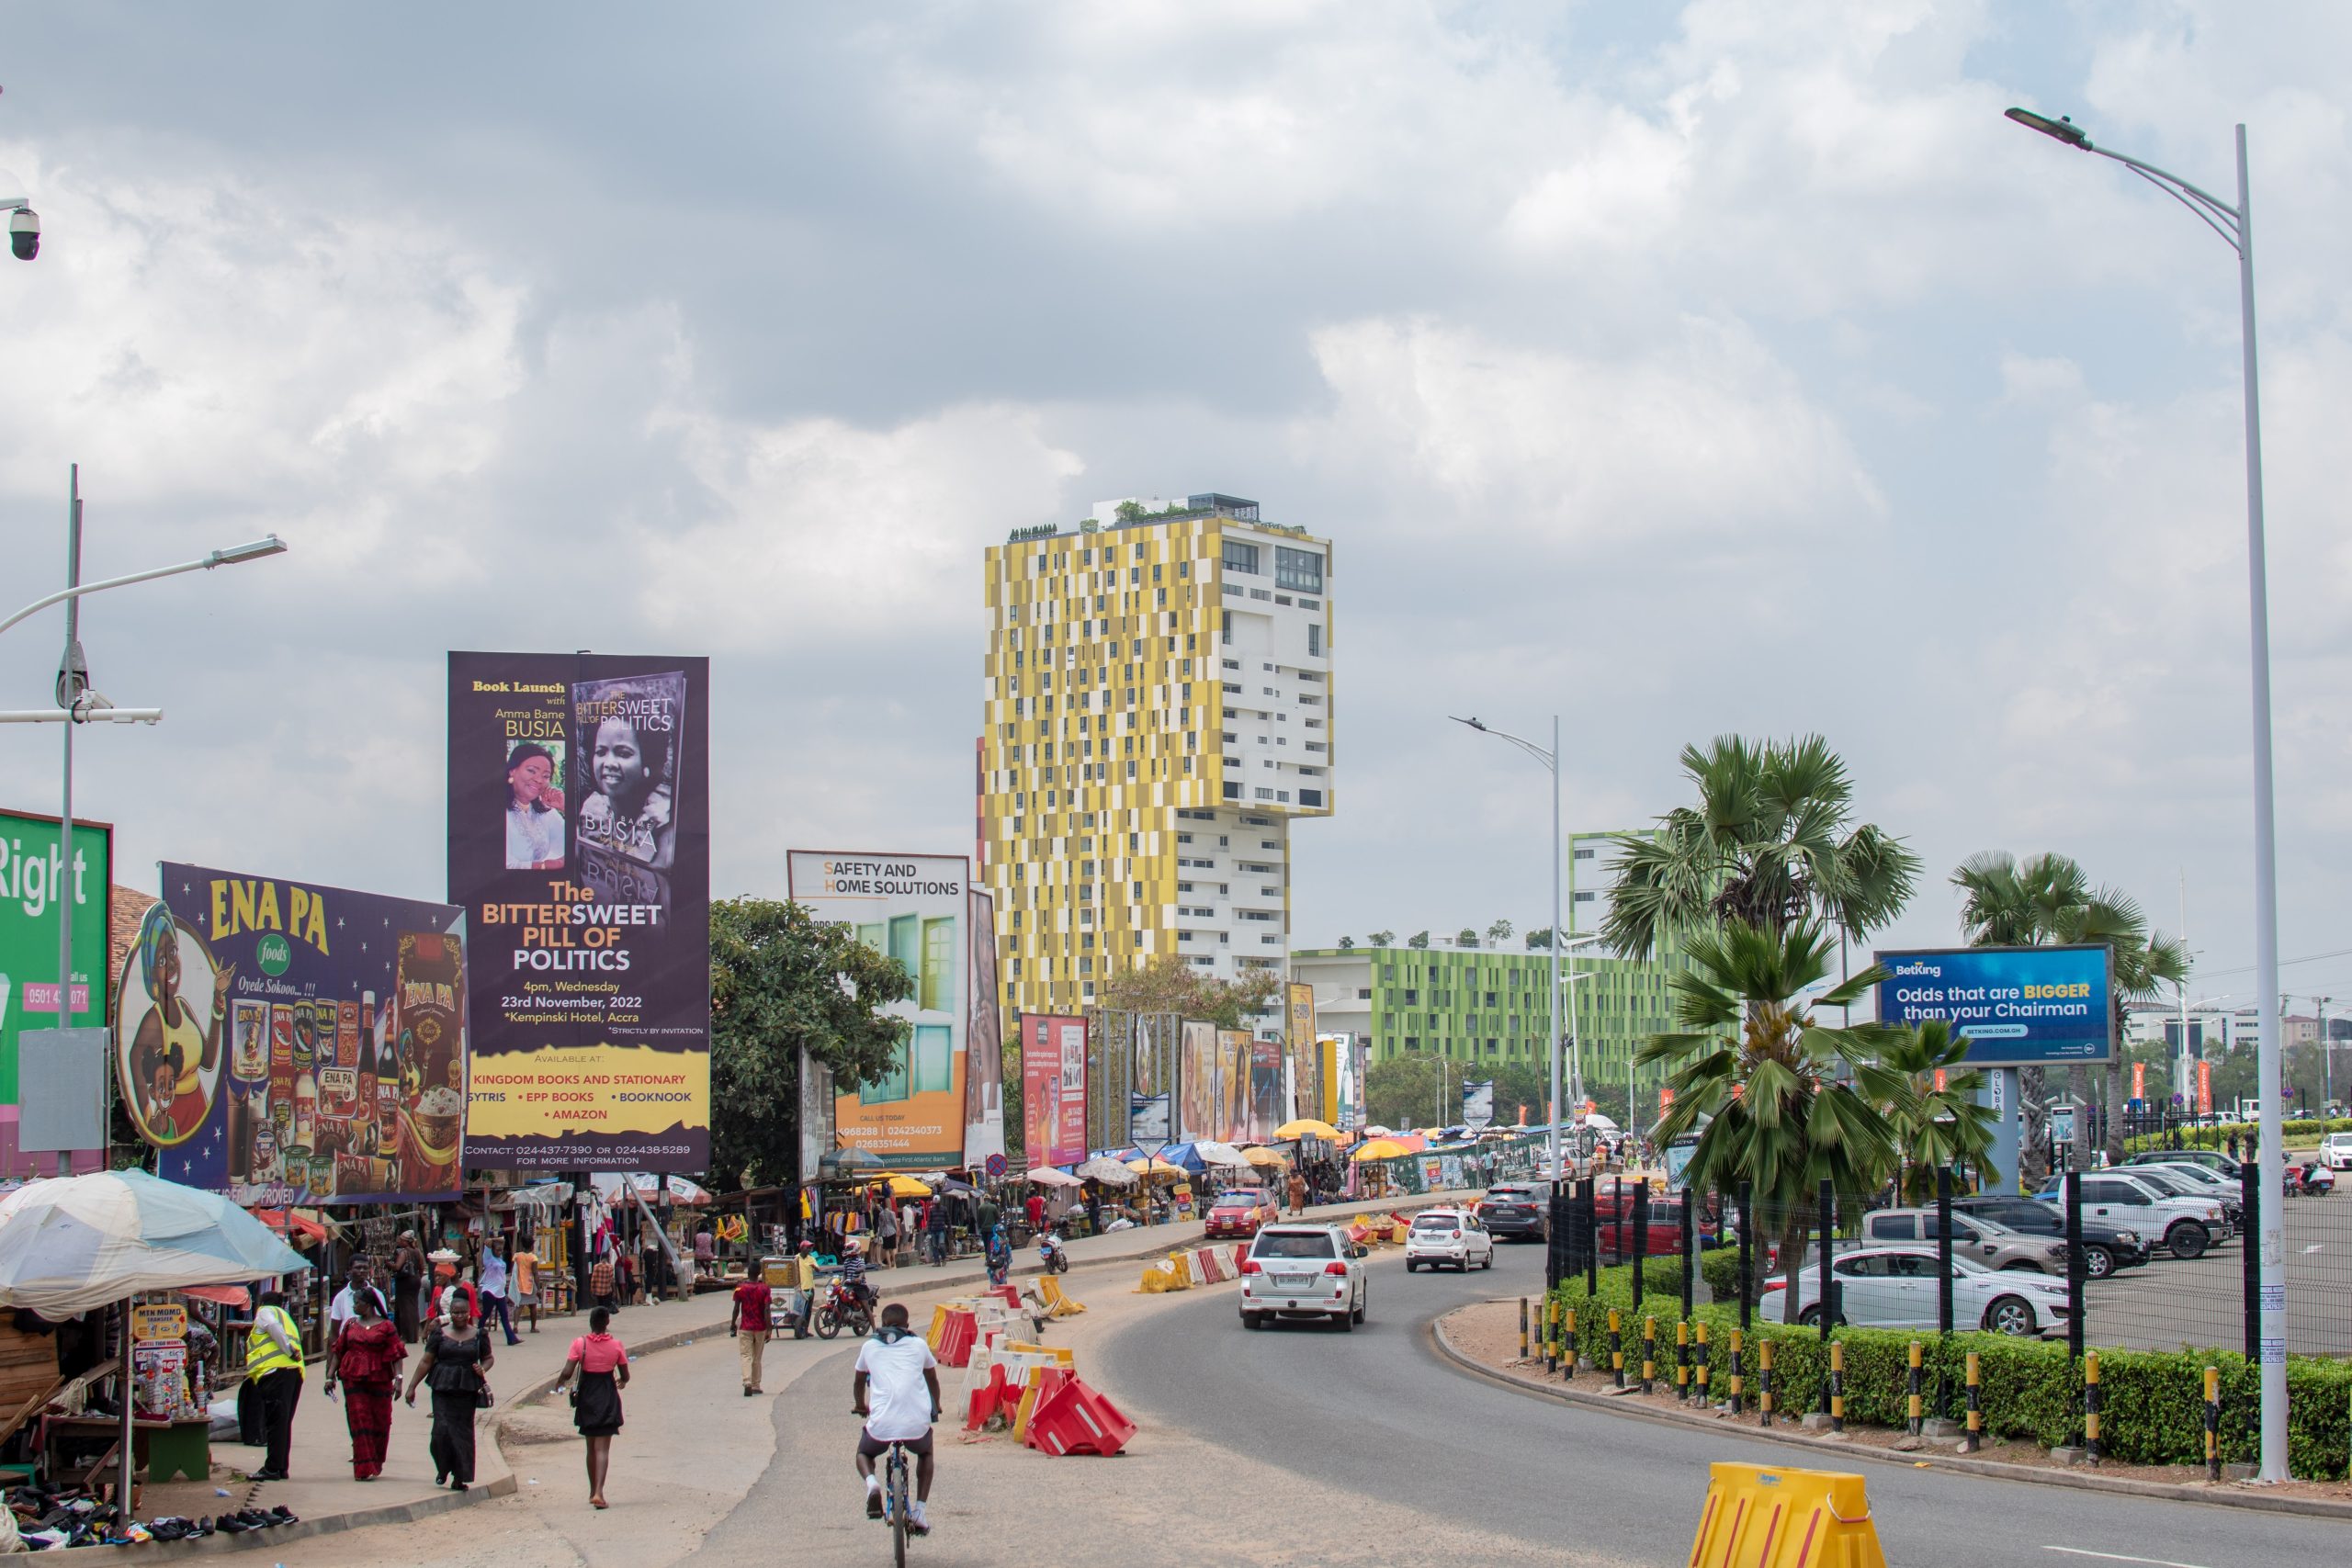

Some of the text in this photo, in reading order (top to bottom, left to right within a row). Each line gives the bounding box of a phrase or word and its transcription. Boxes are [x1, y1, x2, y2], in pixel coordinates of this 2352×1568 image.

[472, 682, 565, 693] Book Launch
[546, 696, 566, 705] with
[610, 691, 625, 700] THE
[495, 709, 565, 719] Amma Bame
[576, 698, 672, 716] BITTERSWEET
[505, 721, 566, 737] BUSIA
[601, 716, 671, 731] POLITICS
[584, 812, 657, 853] BUSIA
[823, 862, 917, 878] SAFETY AND
[549, 881, 594, 902] The
[825, 879, 959, 897] HOME SOLUTIONS
[210, 880, 329, 955] ENA PA
[483, 904, 662, 925] BITTERSWEET
[524, 927, 621, 948] PILL OF
[260, 942, 288, 964] foods
[514, 950, 630, 970] POLITICS
[71, 972, 79, 982] all
[1896, 965, 1940, 977] BetKing
[239, 976, 265, 994] Oyede
[524, 981, 619, 994] 4pm, Wednesday
[29, 988, 50, 1003] 0501
[404, 982, 456, 1012] ENA PA
[1896, 984, 2090, 1003] Odds that are BIGGER
[502, 997, 642, 1010] 23rd November, 2022
[571, 1012, 605, 1023] Hotel,
[608, 1012, 639, 1022] Accra
[1904, 1001, 2087, 1023] than your Chairman
[535, 1055, 586, 1064] AVAILABLE
[325, 1072, 353, 1084] ENA PA
[474, 1075, 685, 1086] KINGDOM BOOKS AND STATIONARY
[526, 1092, 548, 1102] EPP
[552, 1092, 594, 1102] BOOKS
[619, 1091, 692, 1102] BOOKNOOK
[553, 1110, 607, 1120] AMAZON
[316, 1121, 346, 1139] ENA PA
[888, 1126, 943, 1135] 0242340373
[465, 1146, 514, 1156] CONTACT:
[516, 1146, 593, 1156] 024-437-7390
[855, 1139, 910, 1148] 0268351444
[338, 1159, 368, 1176] ENA PA
